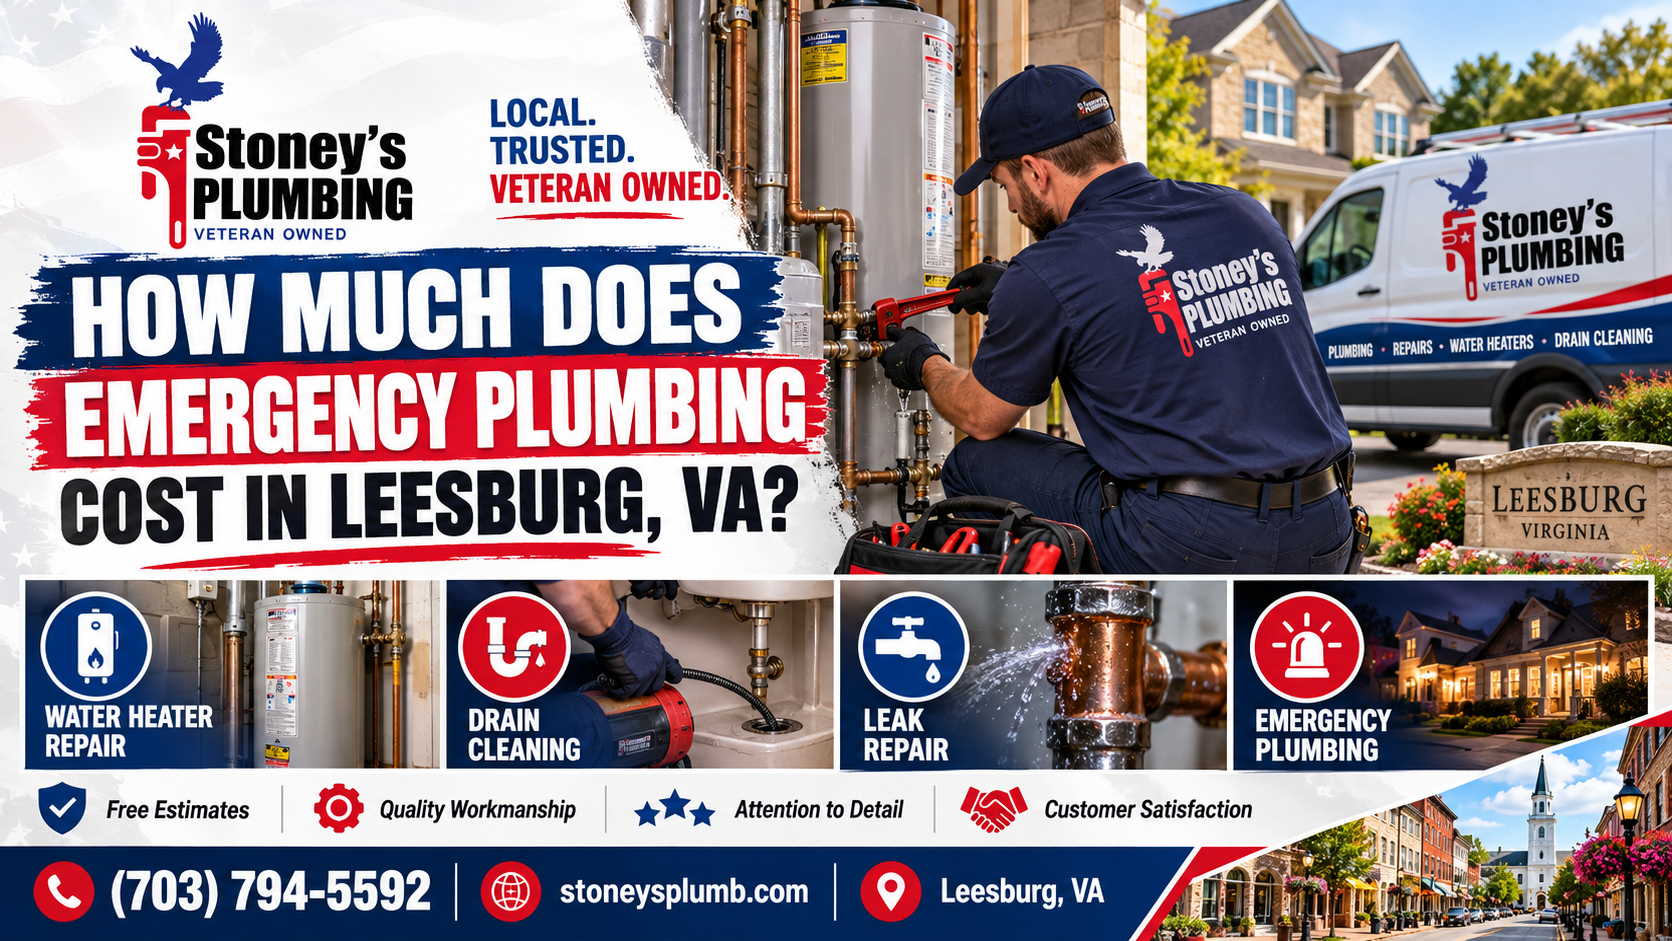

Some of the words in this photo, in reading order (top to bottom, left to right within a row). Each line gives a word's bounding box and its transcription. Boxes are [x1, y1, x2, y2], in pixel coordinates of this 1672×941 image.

[1481, 198, 1614, 242] Stoney's
[1482, 232, 1625, 276] PLUMBING
[1172, 248, 1279, 301] Stoney's
[1482, 277, 1534, 292] VETERAN
[1537, 273, 1580, 287] OWNED
[1181, 278, 1293, 334] PLUMBING
[1195, 325, 1247, 349] VETERAN
[1250, 313, 1290, 332] OWNED
[1328, 343, 1373, 360] PLUMBING
[1392, 340, 1433, 356] REPAIRS
[1449, 337, 1484, 354] WATER
[1487, 334, 1534, 351] HEATERS
[1554, 330, 1590, 348] DRAIN
[1593, 327, 1654, 346] CLEANING
[1492, 484, 1647, 513] LEESBURG
[1521, 523, 1609, 540] VIRGINIA
